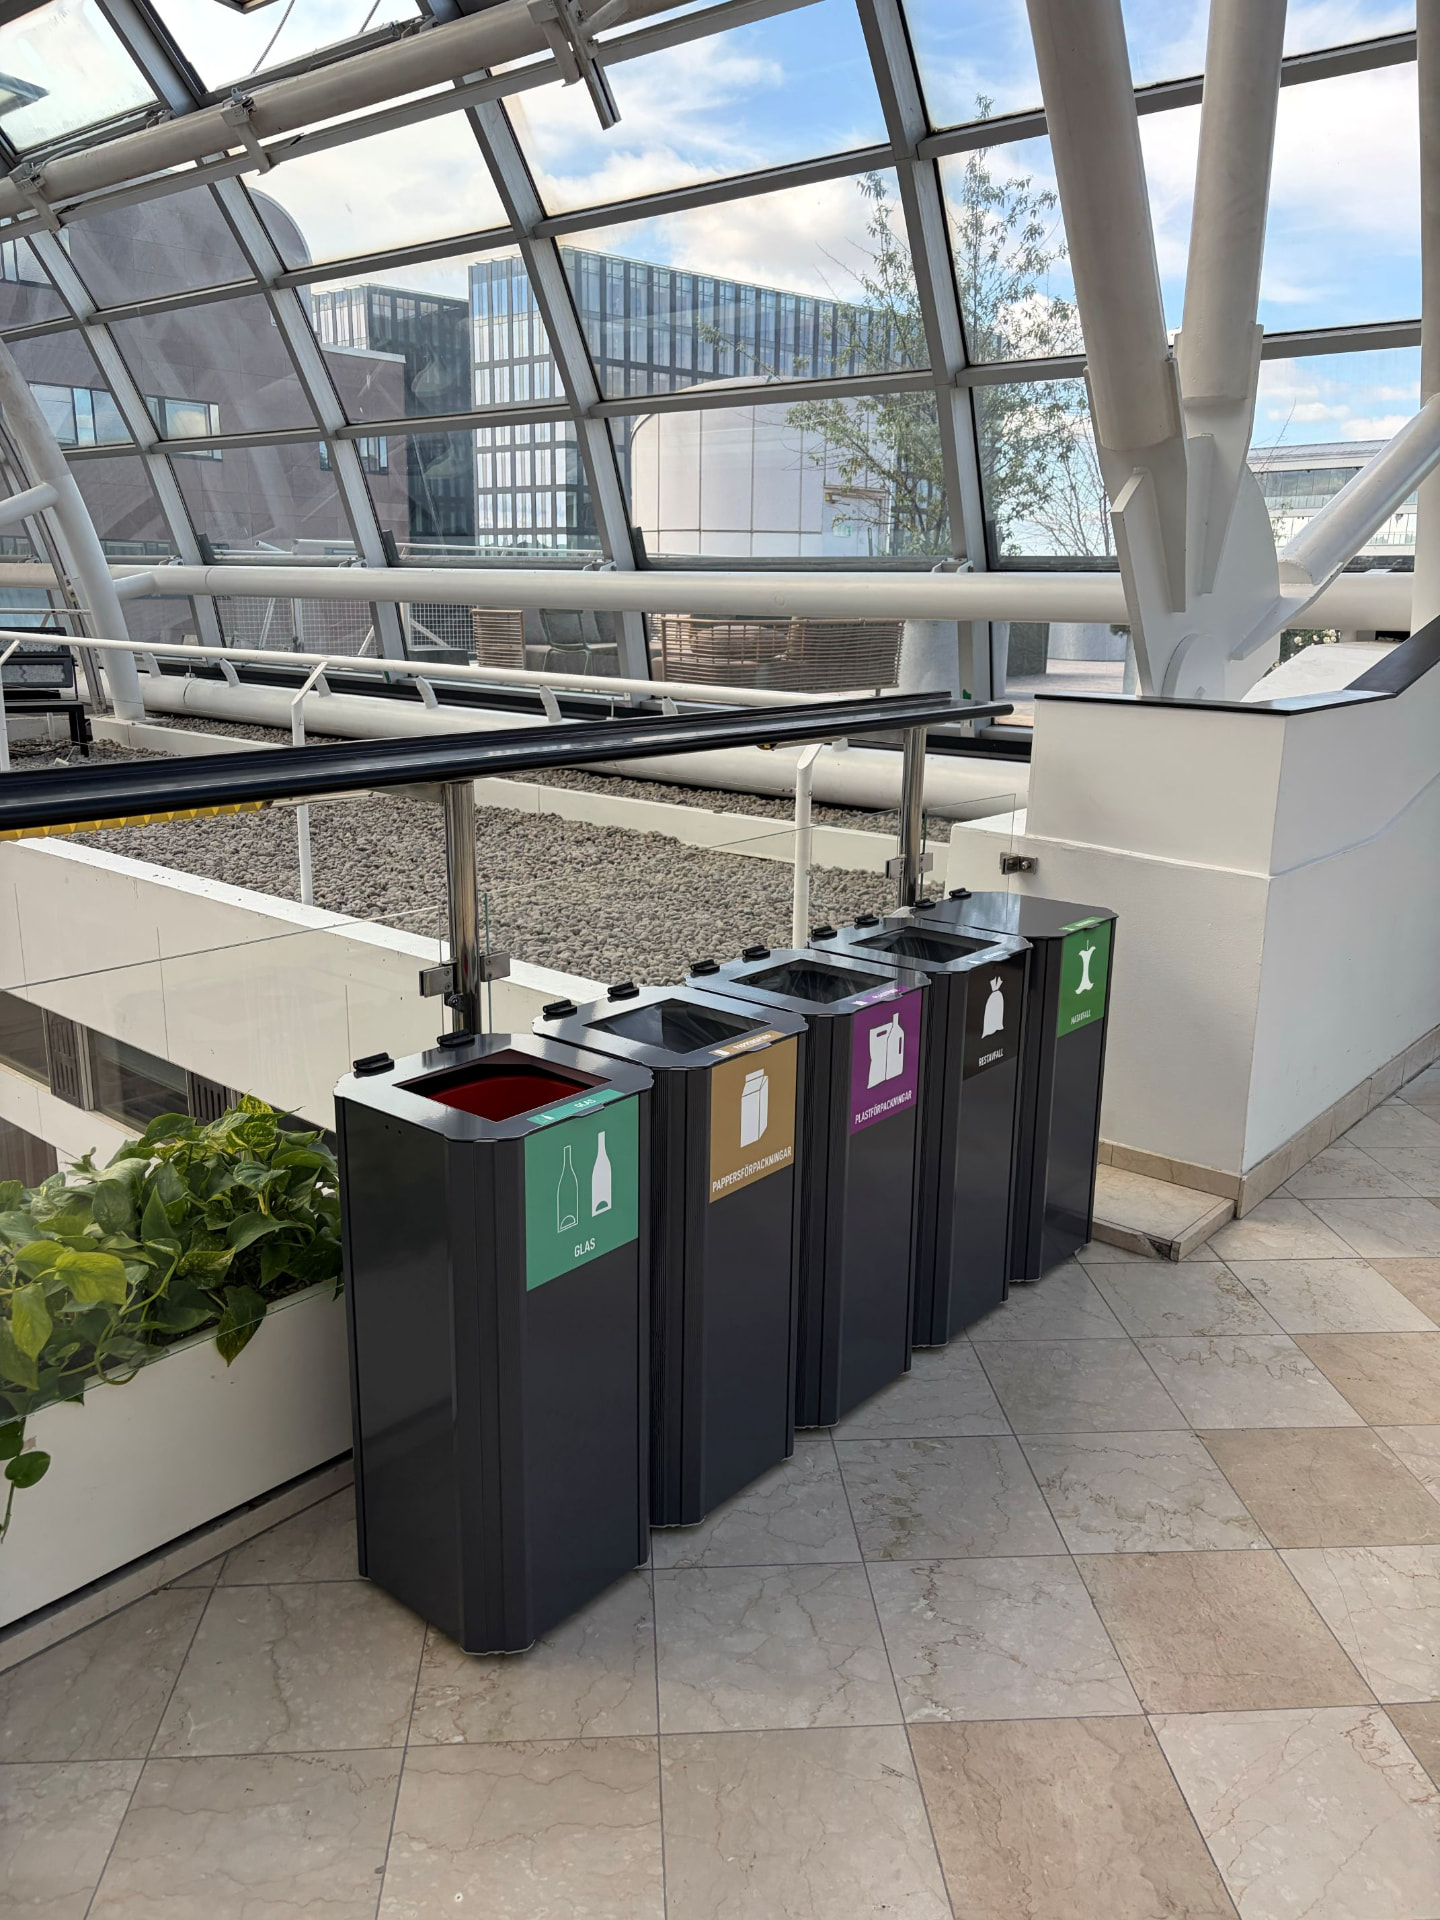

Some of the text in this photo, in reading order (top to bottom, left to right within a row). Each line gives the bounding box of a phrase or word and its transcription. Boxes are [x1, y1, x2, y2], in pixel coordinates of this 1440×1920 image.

[855, 1090, 912, 1124] PLASTFÖRPACKNINGAR
[712, 1146, 792, 1192] PAPPERSFÖRPACKNINGAR
[574, 1238, 596, 1258] GLAS
